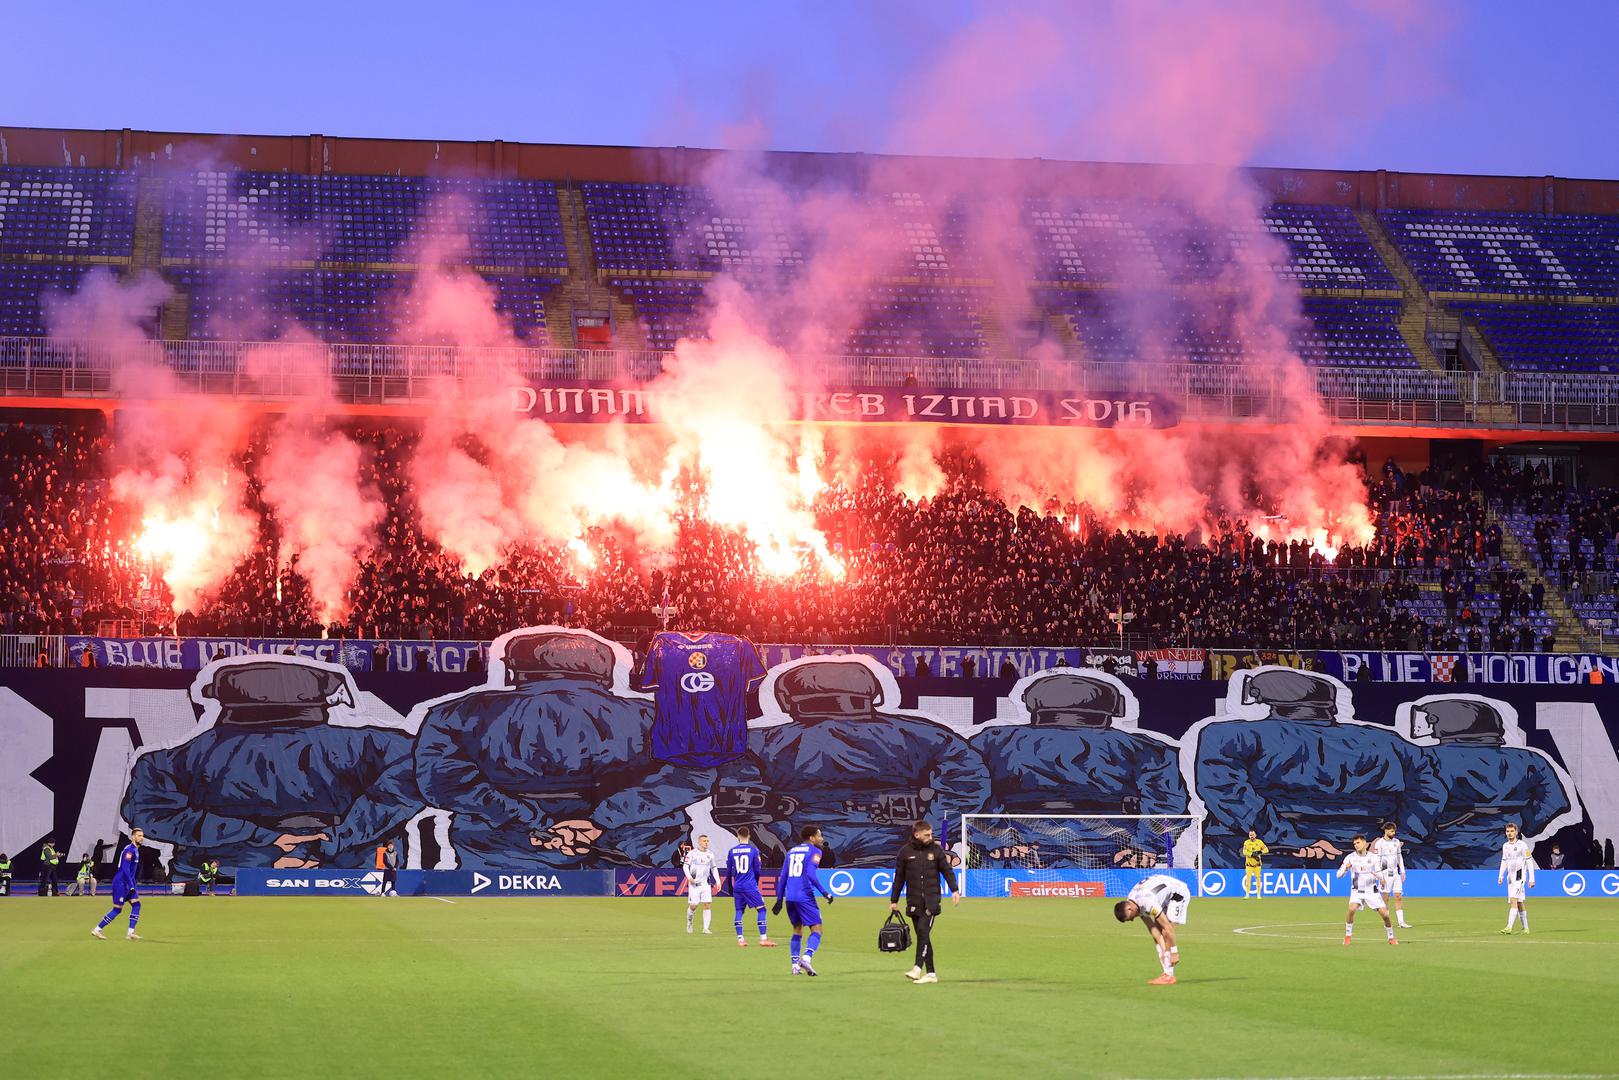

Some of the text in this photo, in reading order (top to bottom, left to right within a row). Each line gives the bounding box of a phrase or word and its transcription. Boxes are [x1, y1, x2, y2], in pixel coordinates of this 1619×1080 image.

[510, 386, 680, 416] DINAM
[902, 394, 1038, 419] IZNAD
[102, 640, 184, 669] BLUE
[1167, 649, 1203, 662] NEVER
[1343, 653, 1426, 683] BLUE
[733, 854, 749, 874] 10
[788, 853, 805, 877] 18
[266, 878, 361, 889] SAN BOX
[498, 875, 562, 890] DEKRA
[1031, 884, 1086, 897] aircash
[1241, 872, 1330, 895] GEALAN
